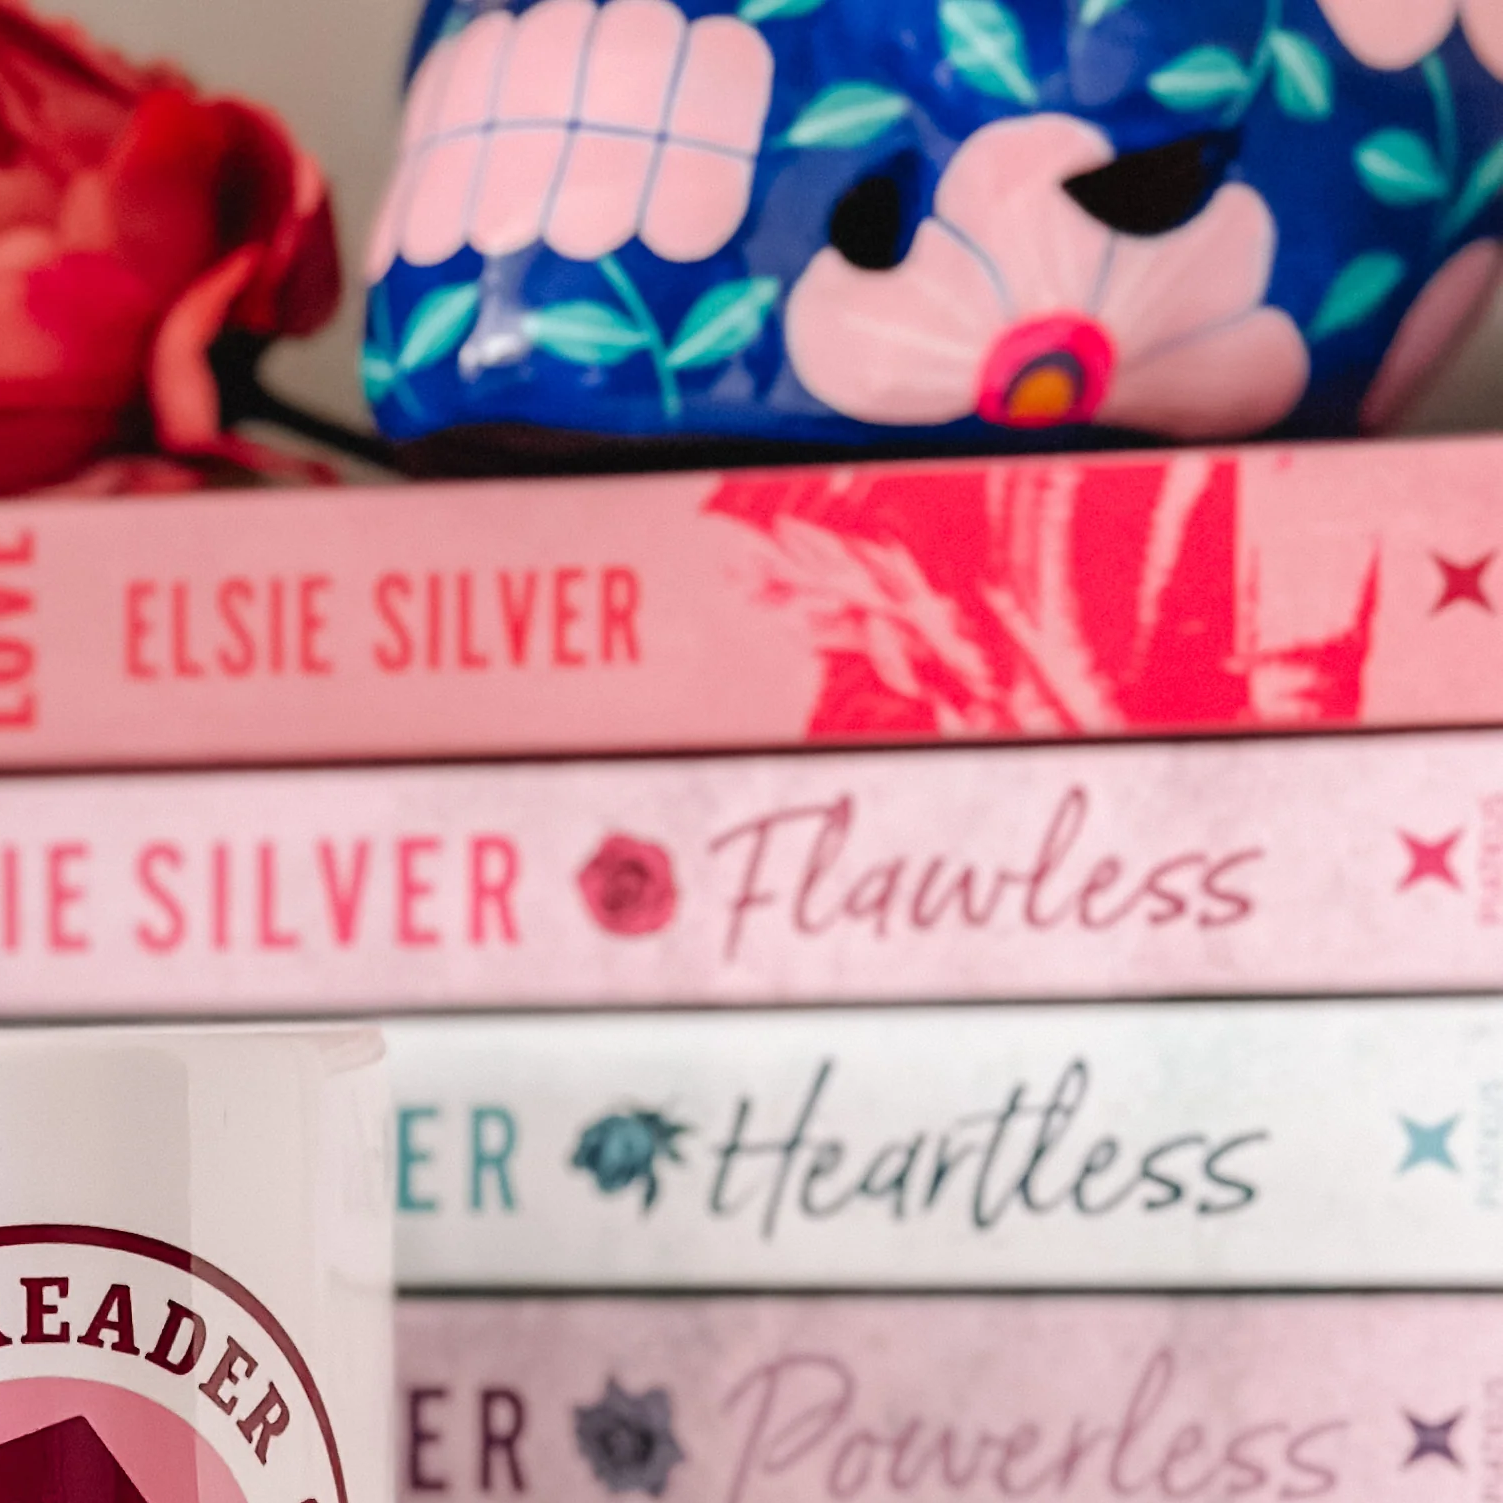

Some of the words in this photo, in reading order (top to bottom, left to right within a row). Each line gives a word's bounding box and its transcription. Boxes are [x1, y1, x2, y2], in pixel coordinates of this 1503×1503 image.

[121, 574, 335, 683] ELSIE
[371, 564, 645, 676] SILVER
[133, 832, 523, 954] SILVER
[708, 784, 1267, 965] Flawless
[706, 1057, 1273, 1244] Heartless
